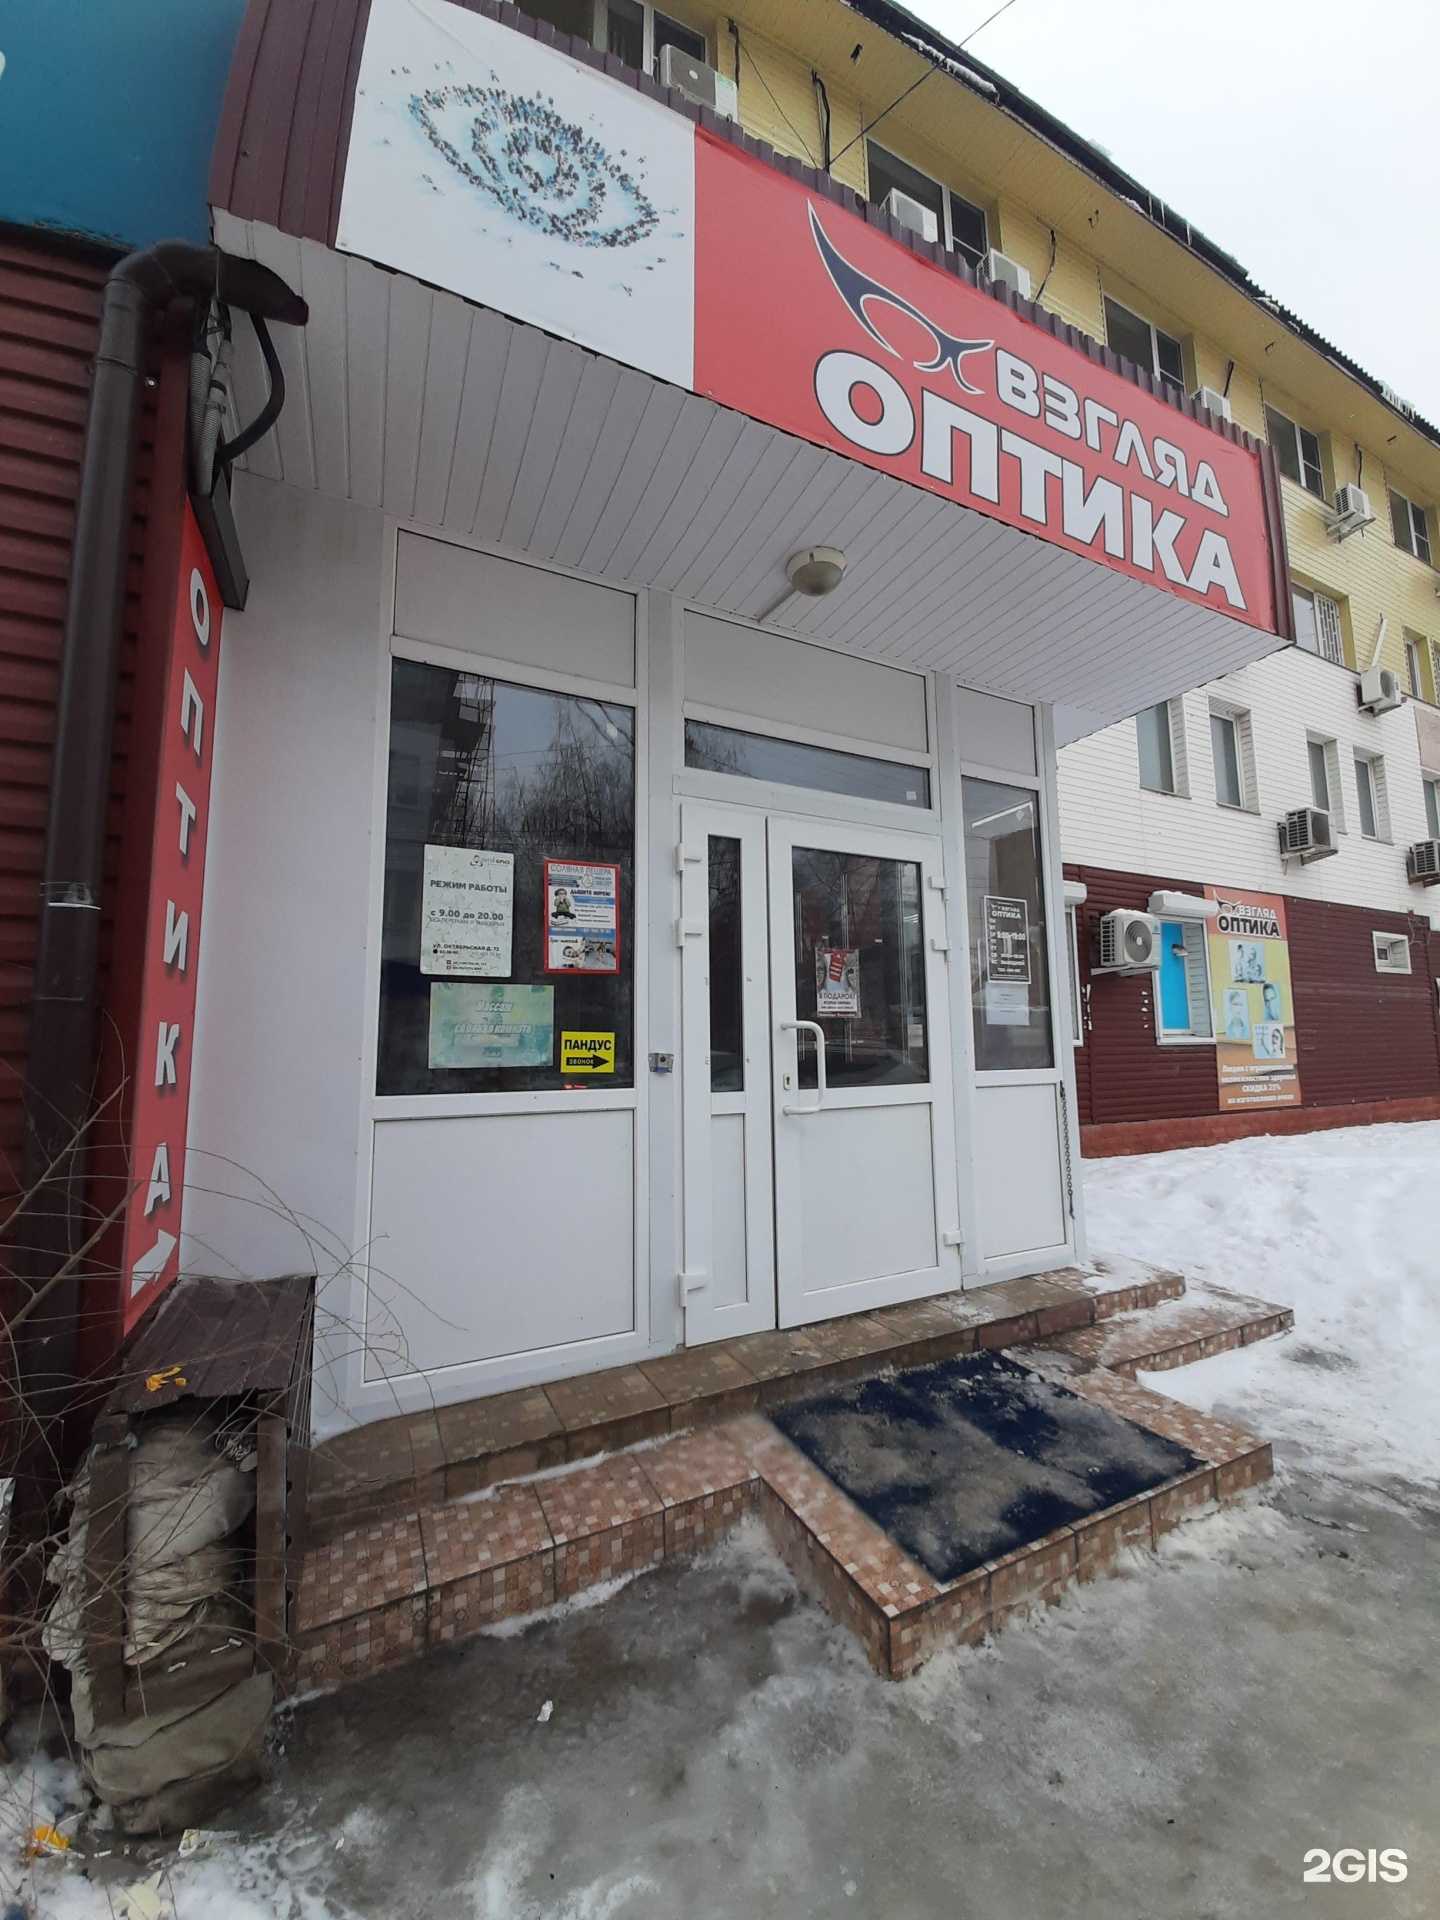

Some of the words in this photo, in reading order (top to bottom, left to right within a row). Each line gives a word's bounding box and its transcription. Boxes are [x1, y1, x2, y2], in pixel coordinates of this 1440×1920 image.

[996, 348, 1229, 517] ВЗГЛЯД
[814, 350, 1248, 611] ОПТИКА
[144, 566, 211, 1217] ОПТИКА
[430, 880, 466, 890] РЕЖИМ
[468, 883, 507, 893] РАБОТЫ
[439, 909, 461, 918] 9.00
[477, 911, 504, 920] 20.00
[991, 910, 1021, 919] ОПТИКА
[1218, 915, 1280, 937] ОПТИКА
[564, 1039, 612, 1052] ПАНДУС
